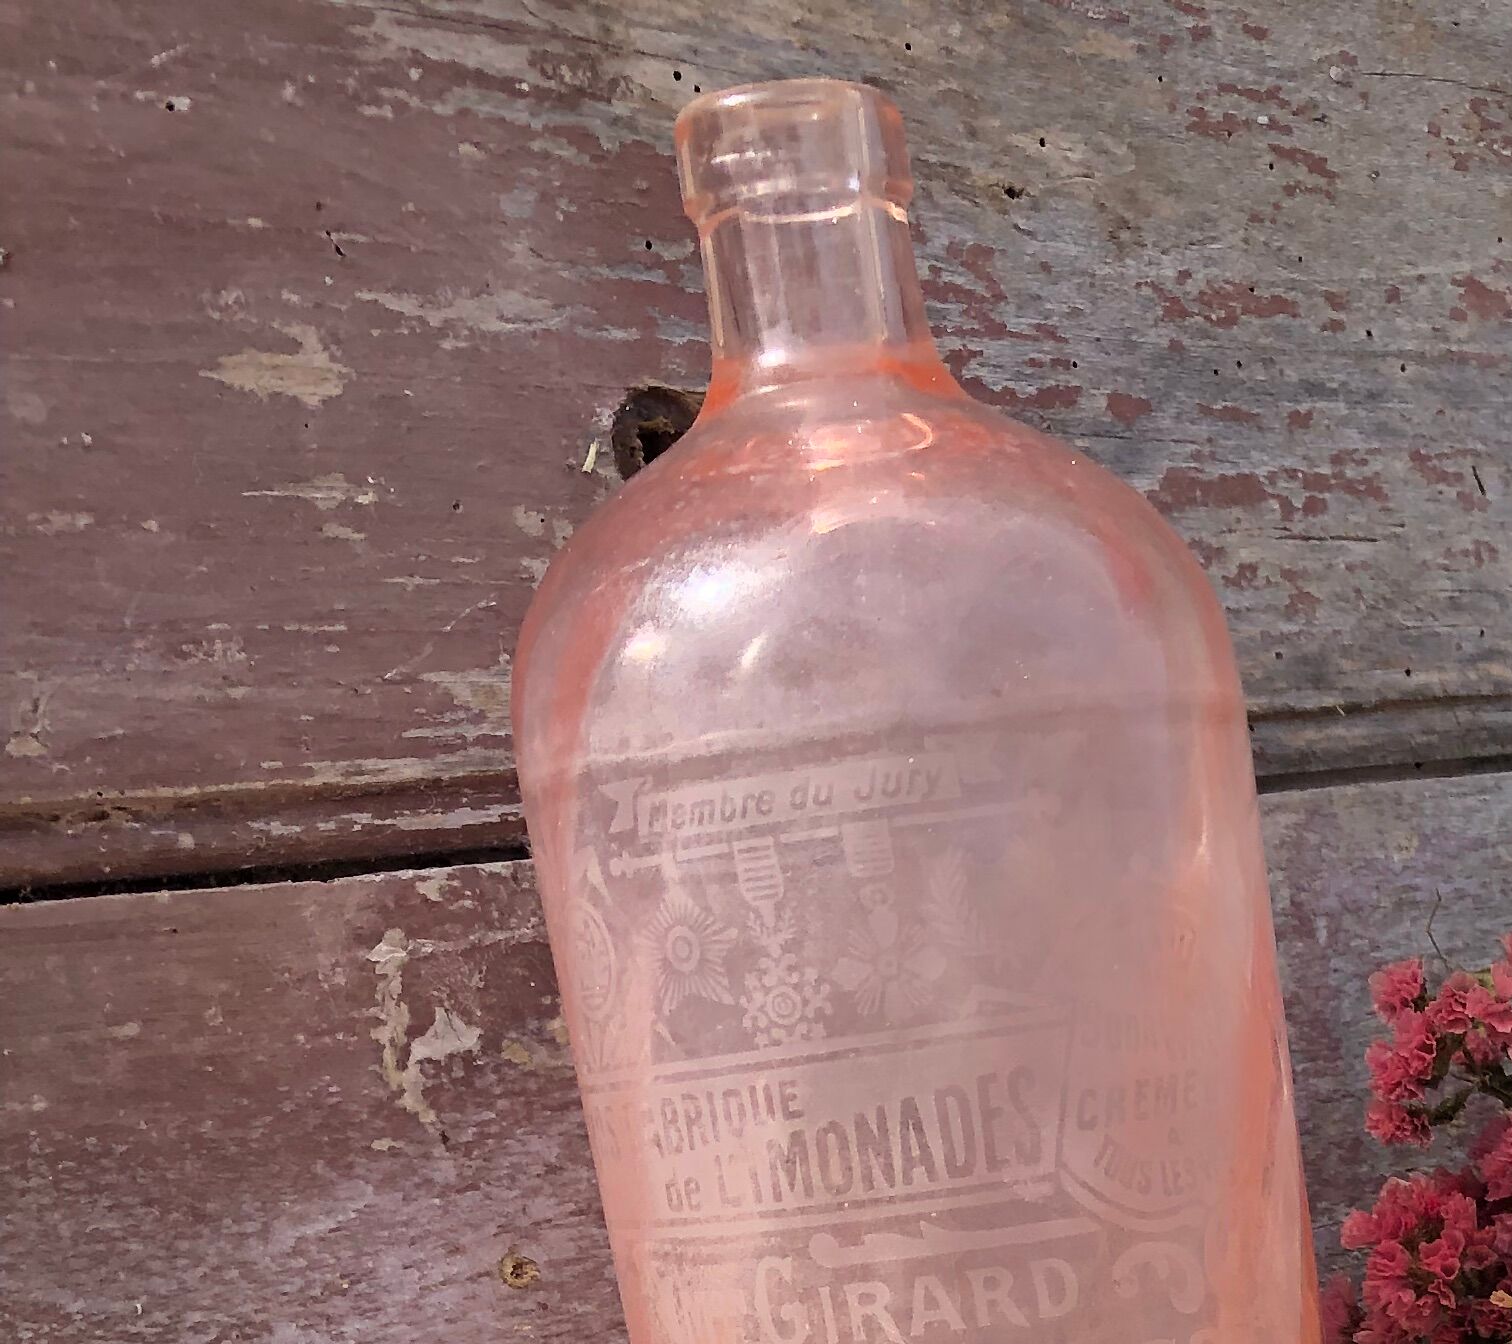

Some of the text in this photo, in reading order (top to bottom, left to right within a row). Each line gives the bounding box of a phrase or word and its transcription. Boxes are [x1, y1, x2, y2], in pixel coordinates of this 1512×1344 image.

[648, 764, 943, 834] Membre du Jury
